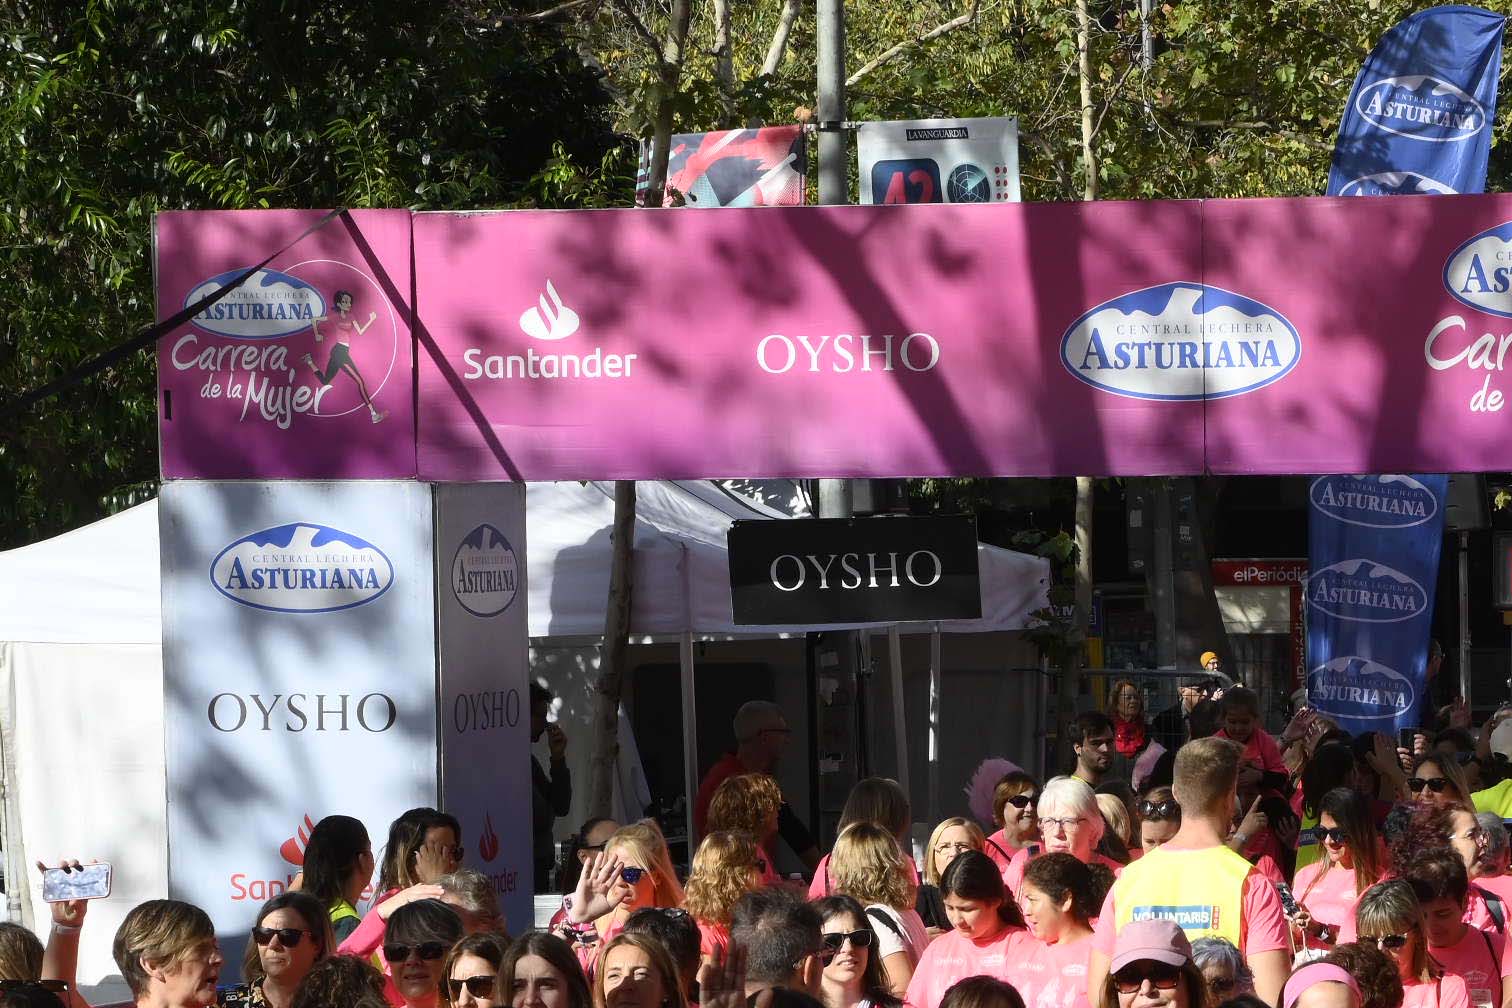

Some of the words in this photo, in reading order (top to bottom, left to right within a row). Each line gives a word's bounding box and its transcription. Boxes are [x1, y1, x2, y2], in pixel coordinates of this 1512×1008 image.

[1364, 91, 1475, 130] ASTURIANA
[195, 294, 314, 321] ASTURIANA
[1116, 323, 1192, 335] CENTRAL
[1199, 322, 1274, 334] LECHERA
[171, 334, 288, 371] Carrera
[463, 348, 637, 379] Santander
[756, 332, 941, 374] OYSHO
[1080, 327, 1283, 370] ASTURIANA
[200, 374, 222, 398] de
[226, 373, 243, 398] la
[239, 368, 334, 430] Mujer
[1469, 373, 1504, 412] de
[1319, 481, 1427, 517] ASTURIANA
[225, 556, 382, 590] ASTURIANA
[252, 553, 310, 563] CENTRAL
[316, 553, 374, 563] LECHERA
[457, 552, 516, 595] ASTURIANA
[769, 549, 943, 593] OYSHO
[1313, 577, 1418, 611] ASTURIANA
[207, 692, 397, 733] OYSHO
[453, 689, 520, 734] OYSHO
[1312, 678, 1407, 709] ASTURIANA
